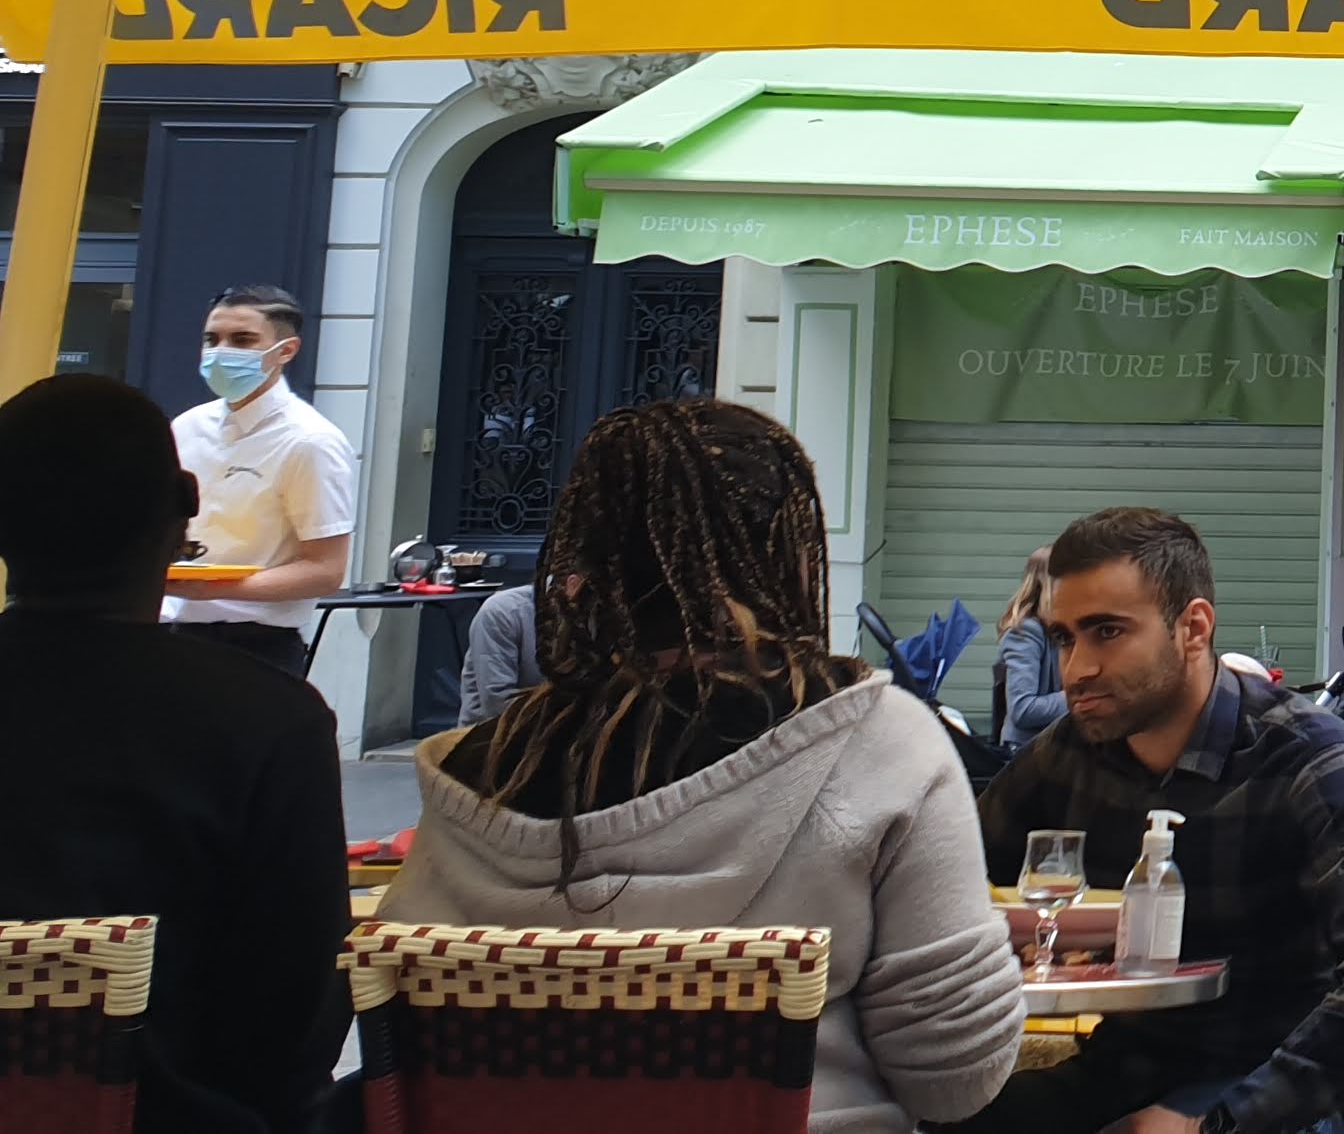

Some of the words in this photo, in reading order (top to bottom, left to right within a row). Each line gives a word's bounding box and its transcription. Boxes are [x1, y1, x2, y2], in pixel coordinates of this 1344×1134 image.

[640, 216, 720, 233] DEPUIS
[724, 218, 768, 239] 1987
[904, 214, 1063, 247] EPHESE
[1177, 228, 1229, 245] FAIT
[1233, 230, 1318, 247] MAISON
[1073, 282, 1220, 319] EPHESE
[959, 349, 1166, 379] OUVERTURE
[1176, 353, 1213, 378] LE
[1223, 359, 1241, 385] 7
[1245, 352, 1325, 384] JUIN
